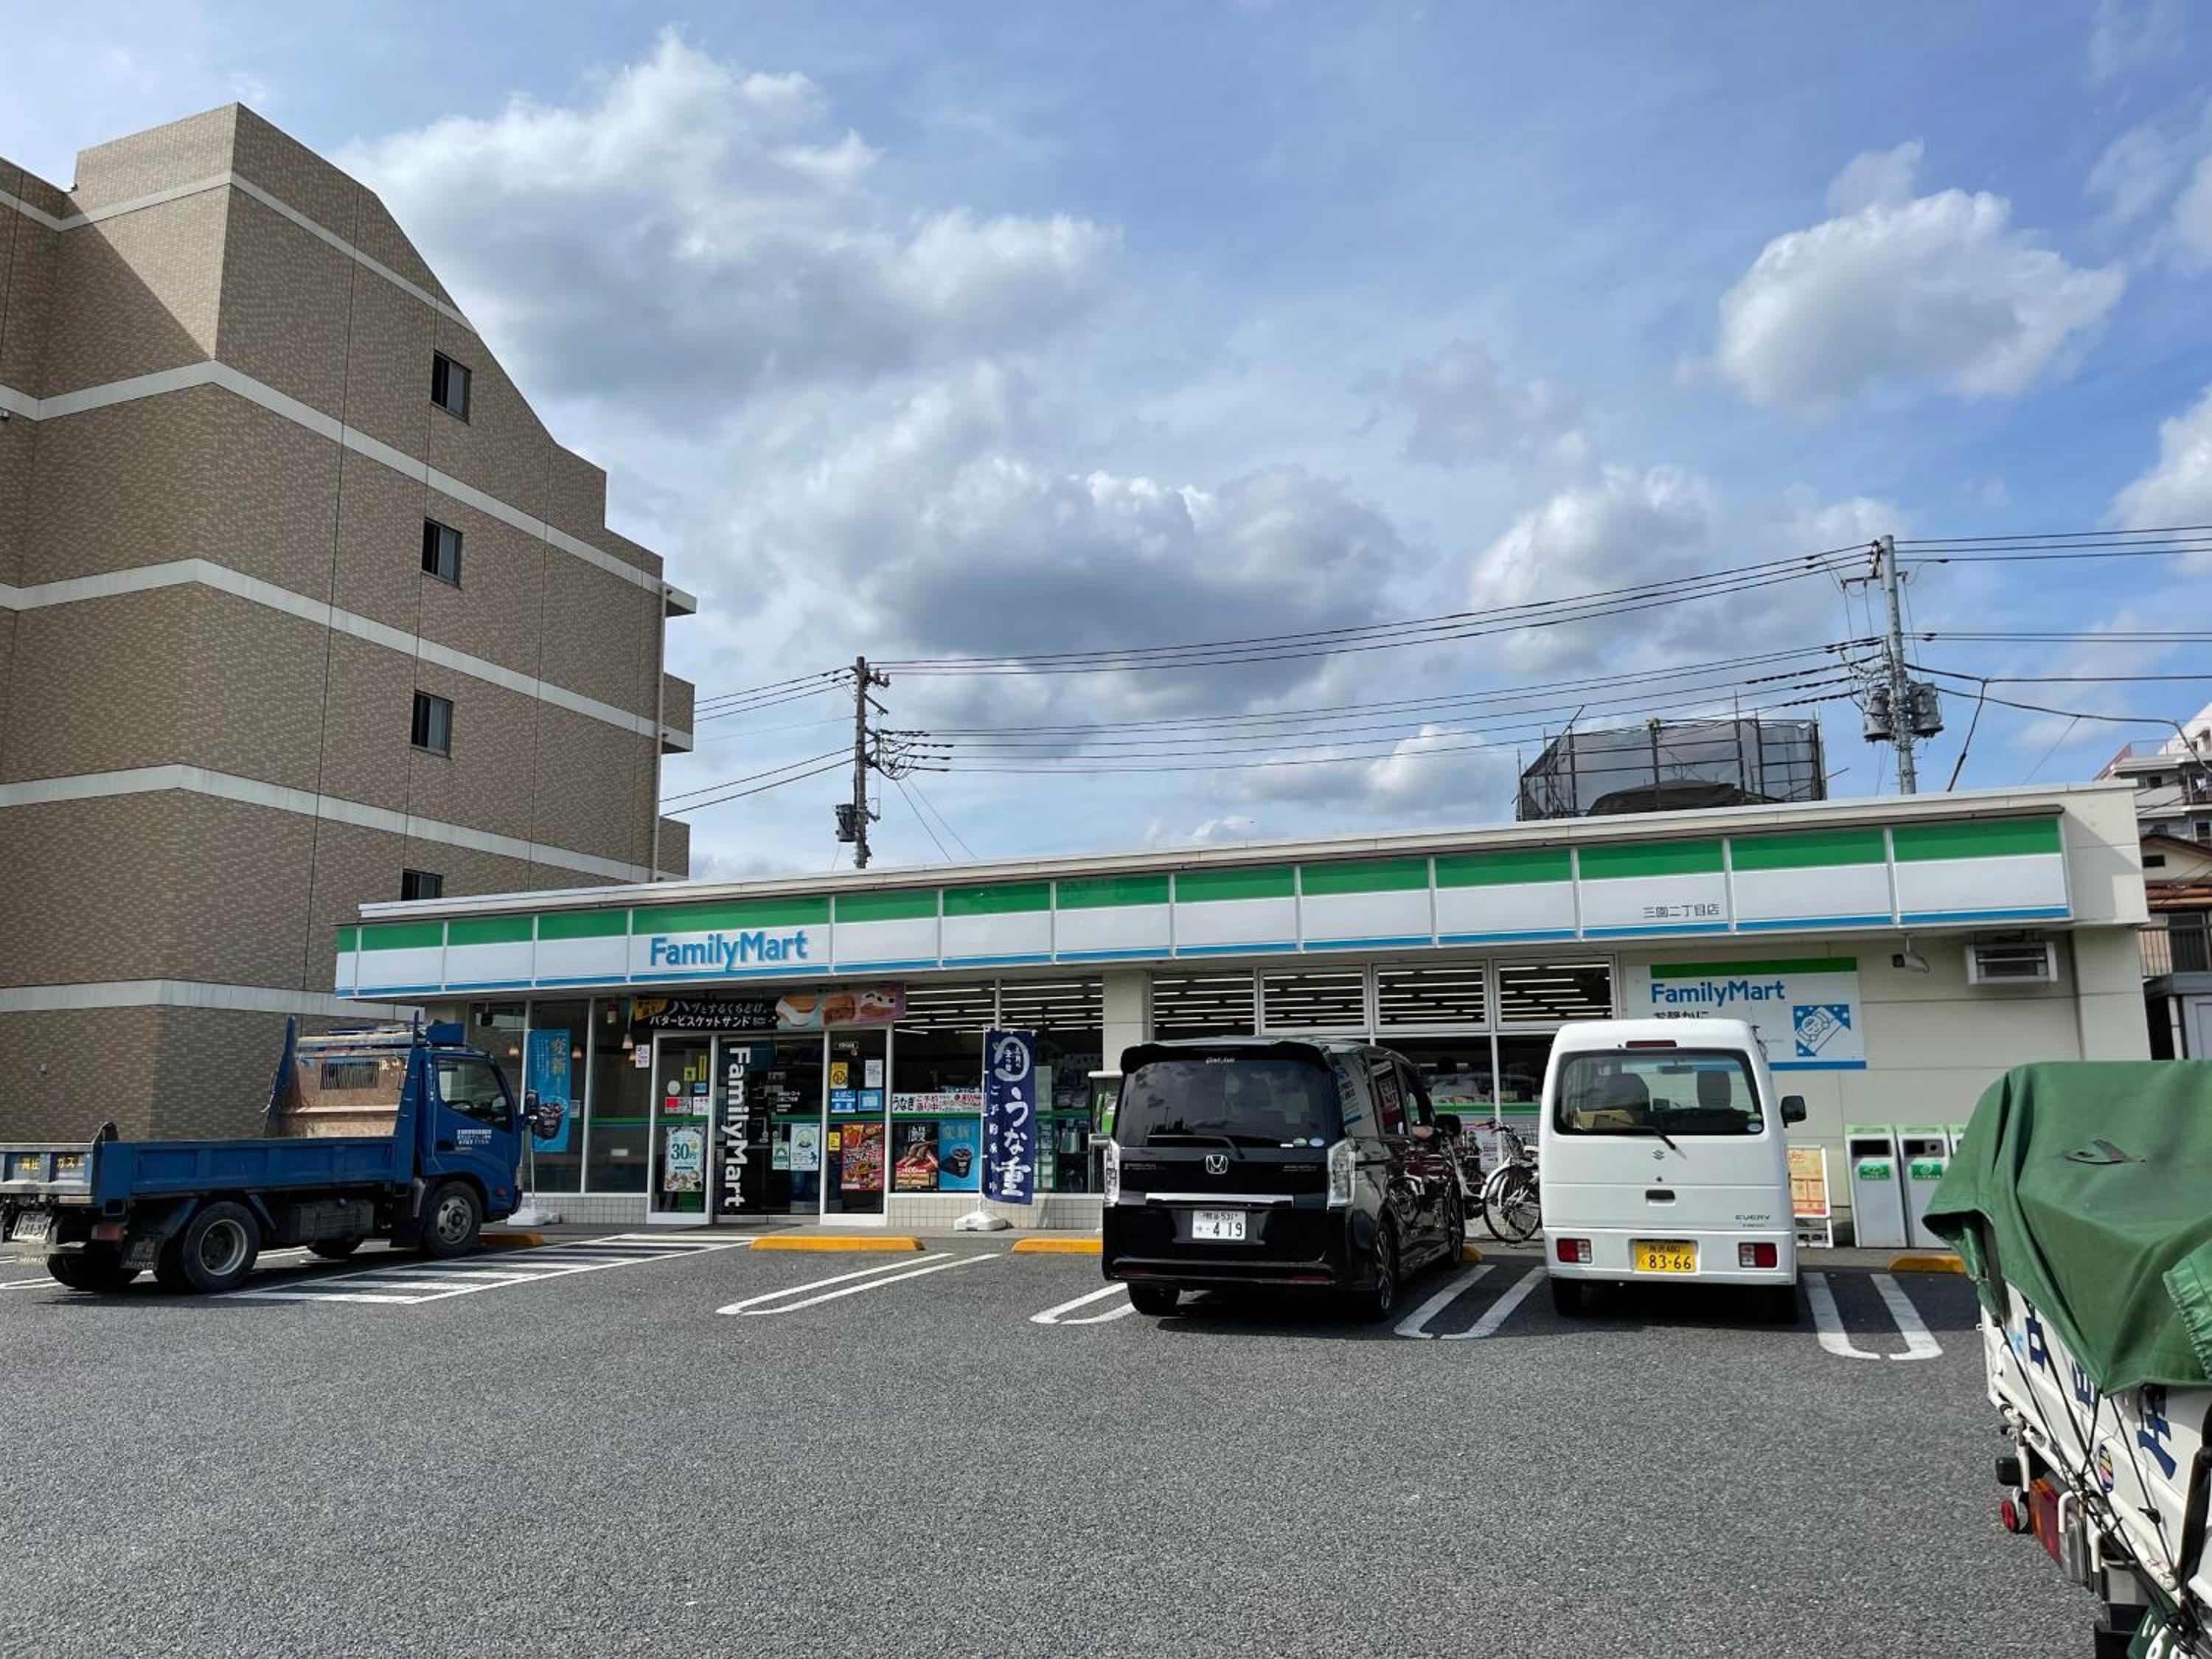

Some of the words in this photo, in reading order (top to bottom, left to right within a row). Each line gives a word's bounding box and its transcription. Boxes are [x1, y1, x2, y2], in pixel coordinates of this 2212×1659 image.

[650, 930, 809, 972] FamilyMart
[1651, 981, 1785, 1007] FamilyMart
[893, 1096, 914, 1111] うなぎ
[720, 1046, 752, 1207] FamilyMart
[996, 1086, 1032, 1196] うな重
[1649, 1254, 1691, 1269] 83-66
